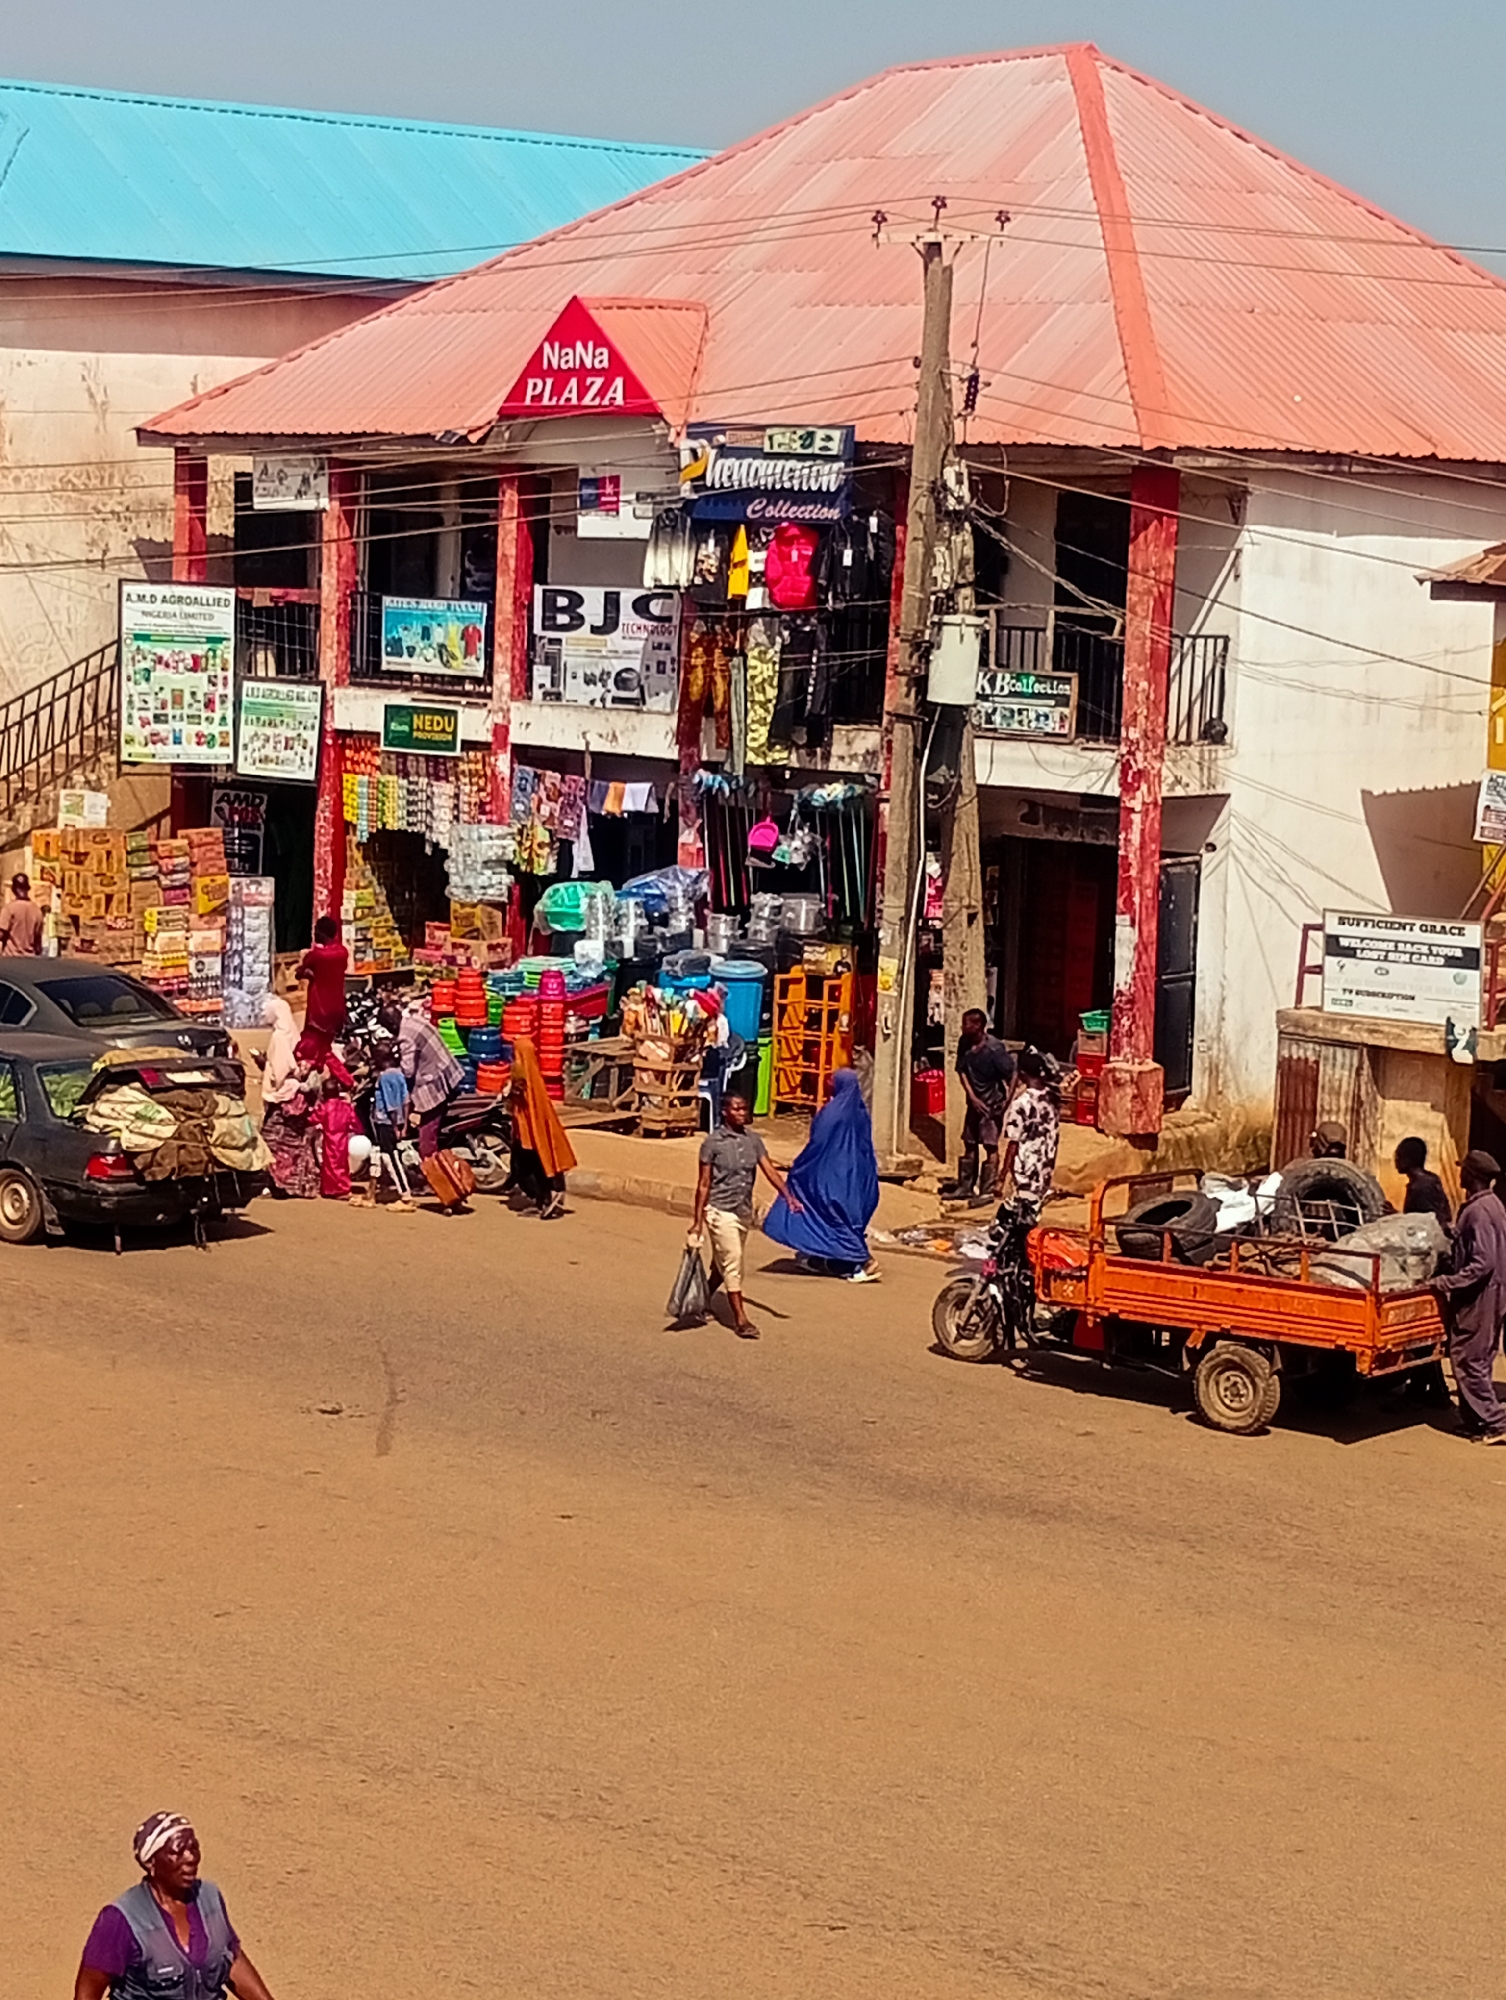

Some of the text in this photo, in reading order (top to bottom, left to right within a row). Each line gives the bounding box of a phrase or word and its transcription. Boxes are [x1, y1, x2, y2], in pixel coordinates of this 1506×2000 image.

[542, 340, 609, 370] NaNa
[524, 375, 625, 406] PLAZA
[746, 498, 841, 520] Collection
[161, 594, 231, 608] AGROALLIED
[541, 588, 674, 635] BJC
[621, 623, 678, 637] TECHNOLOGY
[413, 713, 454, 732] NEDU
[216, 792, 264, 808] AMD
[228, 805, 262, 823] POS
[1337, 916, 1466, 937] SUFFICIENT GRACE
[1338, 937, 1464, 958] WELCOME BACK YOUR
